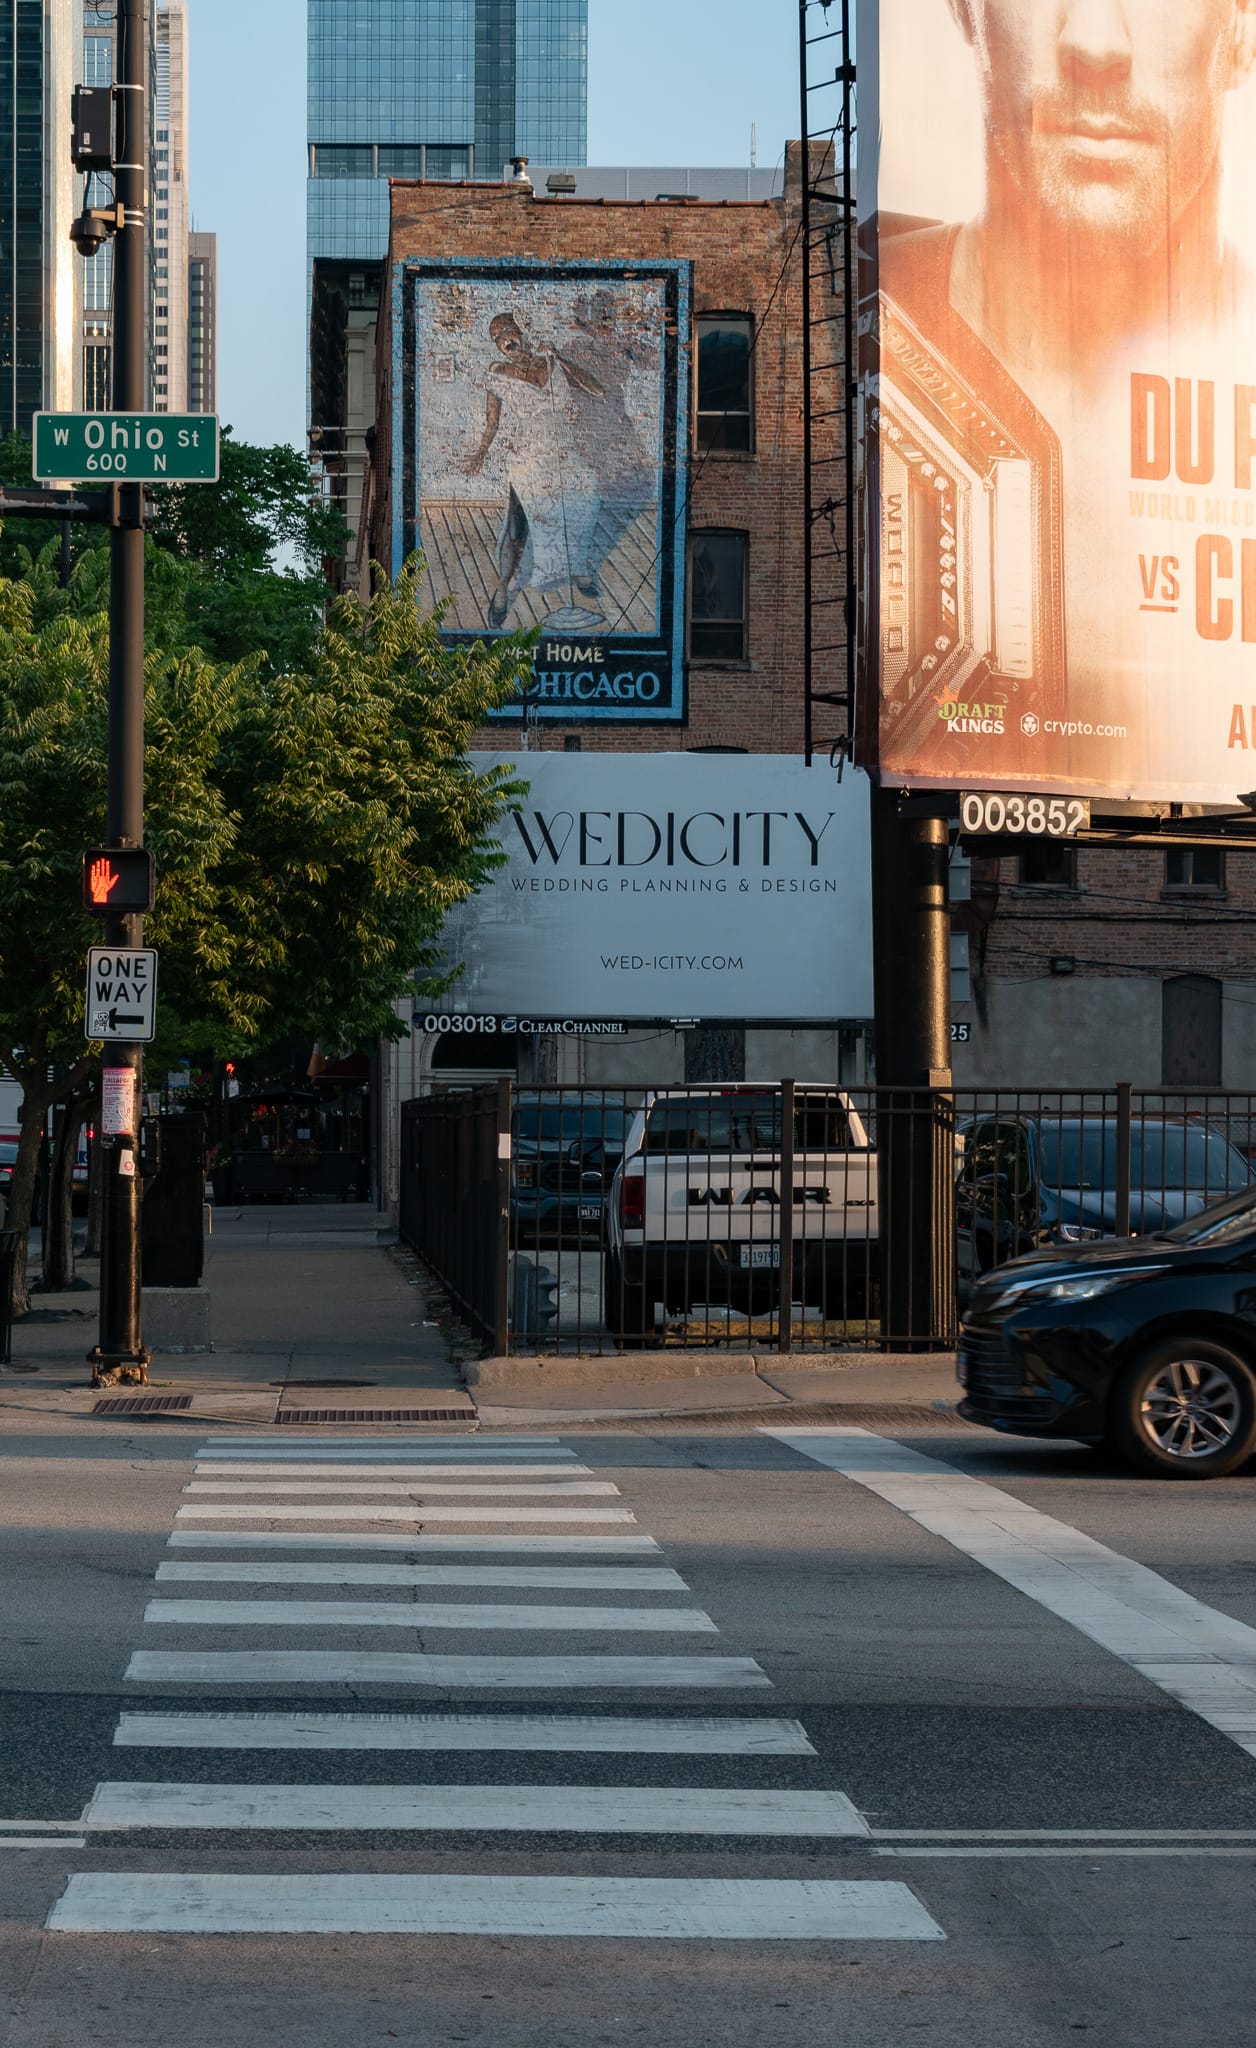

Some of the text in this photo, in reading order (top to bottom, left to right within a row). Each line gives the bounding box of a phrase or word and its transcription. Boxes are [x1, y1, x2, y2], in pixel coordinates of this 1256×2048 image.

[53, 420, 200, 450] W Ohio St
[1130, 372, 1215, 485] DU
[86, 453, 167, 471] 600 N
[1128, 490, 1196, 523] WORLD
[1138, 554, 1180, 601] VS
[546, 642, 605, 663] HOME
[937, 701, 1007, 720] DRAFT
[946, 716, 1005, 734] KINGS
[1043, 719, 1128, 738] crypto.com
[962, 795, 1085, 835] 003852
[512, 811, 837, 867] WEDICITY
[511, 878, 837, 893] WEDDING PLANNING & DESIGN
[97, 956, 147, 978] ONE
[600, 955, 744, 970] WED-ICITY.COM
[95, 981, 148, 1003] WAY
[424, 1015, 496, 1033] 003013
[687, 1187, 833, 1206] WAR
